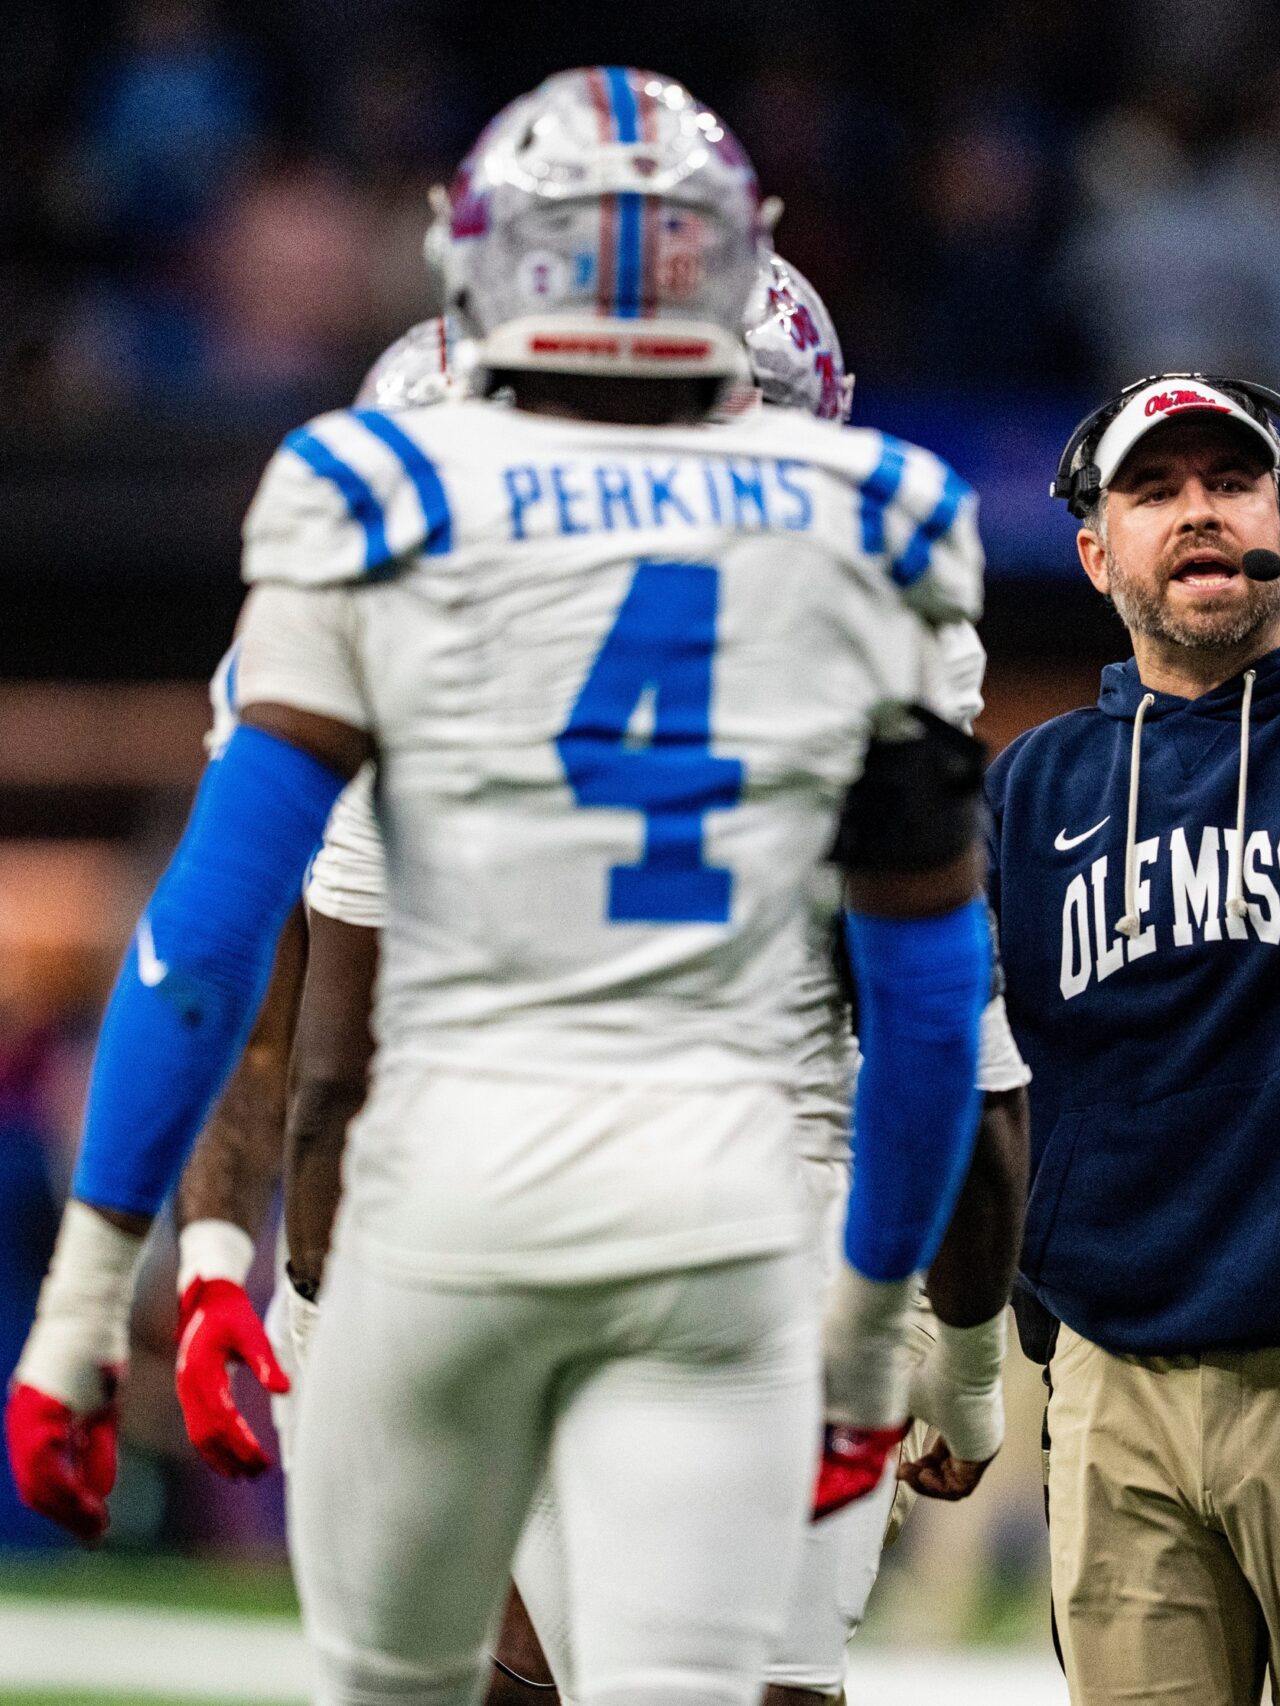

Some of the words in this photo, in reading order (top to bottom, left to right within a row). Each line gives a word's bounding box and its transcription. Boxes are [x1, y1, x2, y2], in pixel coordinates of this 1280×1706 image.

[502, 456, 814, 540] PERKINS
[557, 558, 743, 923] 4
[1059, 836, 1160, 1001] OLE
